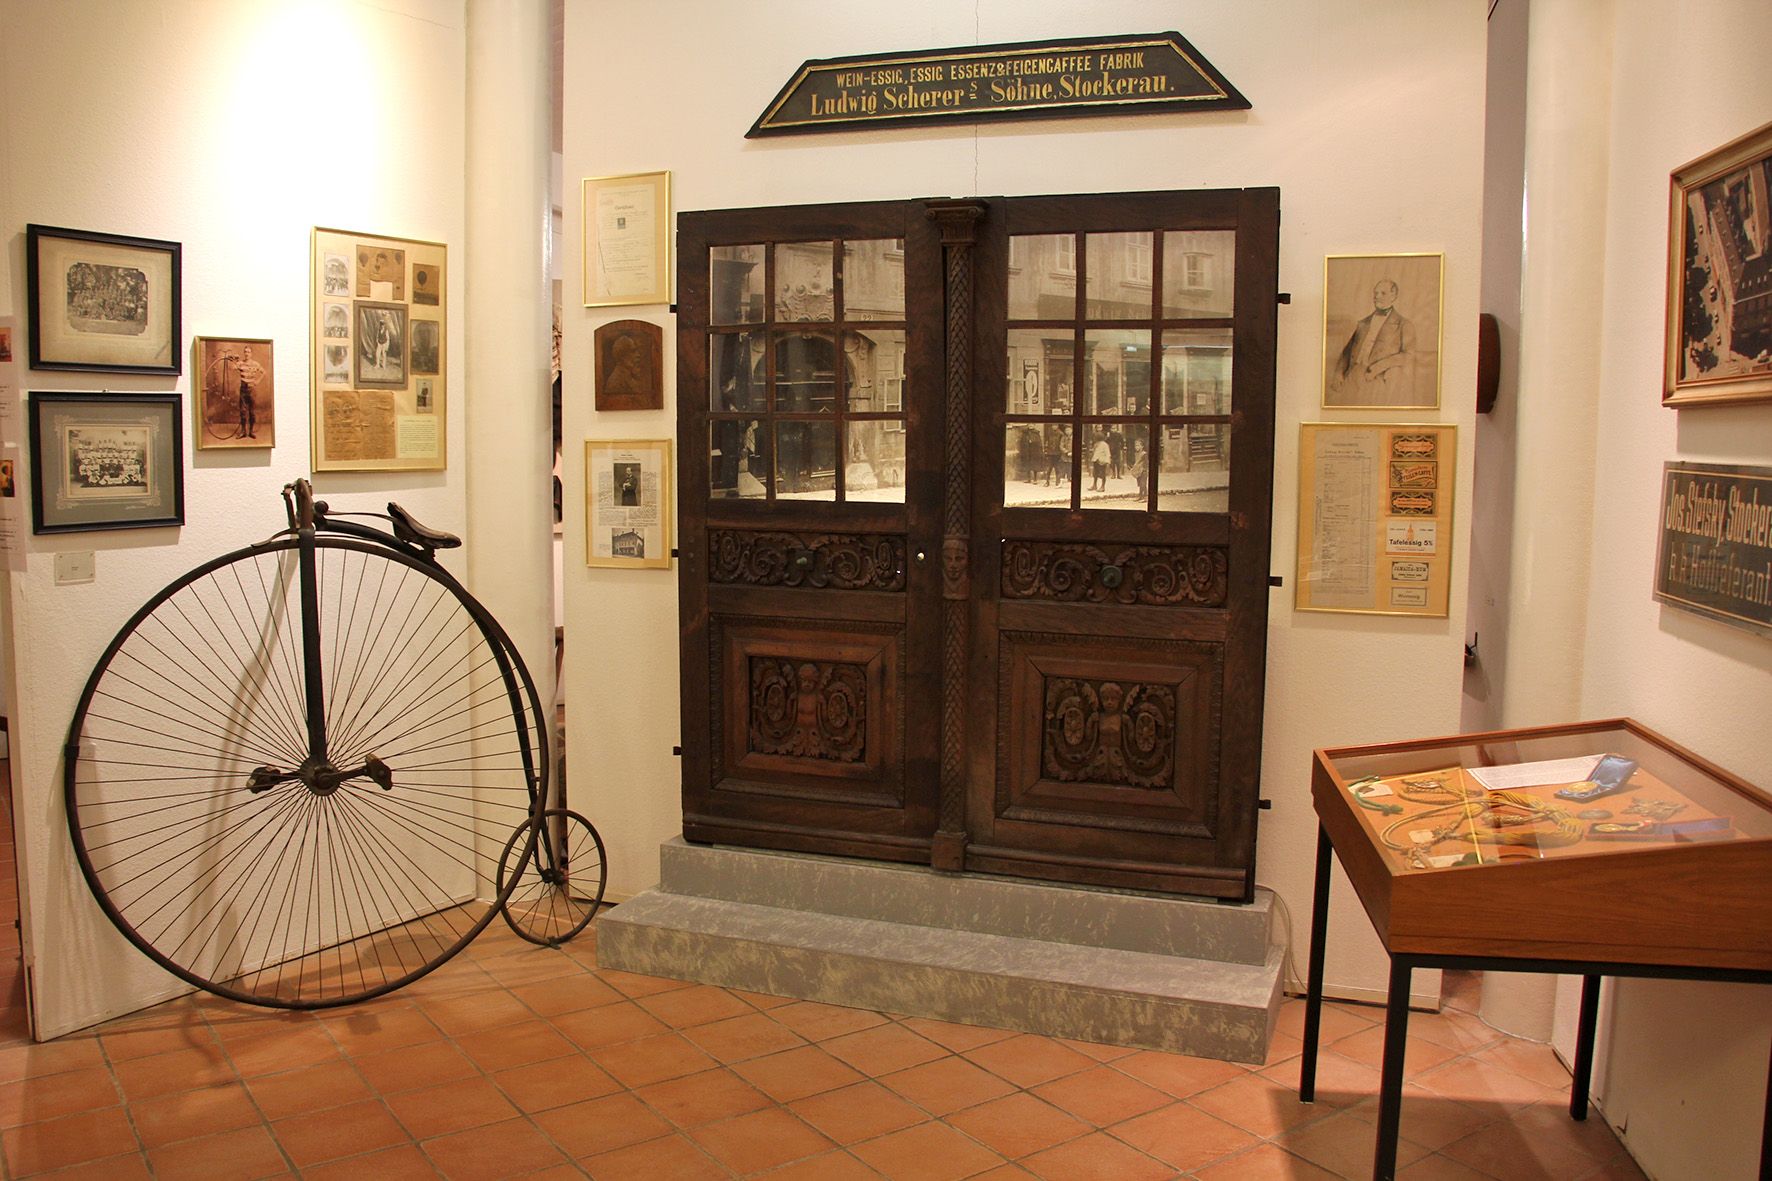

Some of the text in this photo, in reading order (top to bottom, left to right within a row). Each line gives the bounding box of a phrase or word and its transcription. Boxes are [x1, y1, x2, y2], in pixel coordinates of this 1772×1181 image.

[911, 66, 944, 83] ESSIG
[1100, 52, 1145, 70] FABRIK
[811, 90, 878, 115] Ludwig
[883, 86, 965, 111] Scherer
[1059, 71, 1175, 98] Stockerau.
[1665, 479, 1685, 532] Jos.
[1389, 539, 1422, 547] Tafelessig
